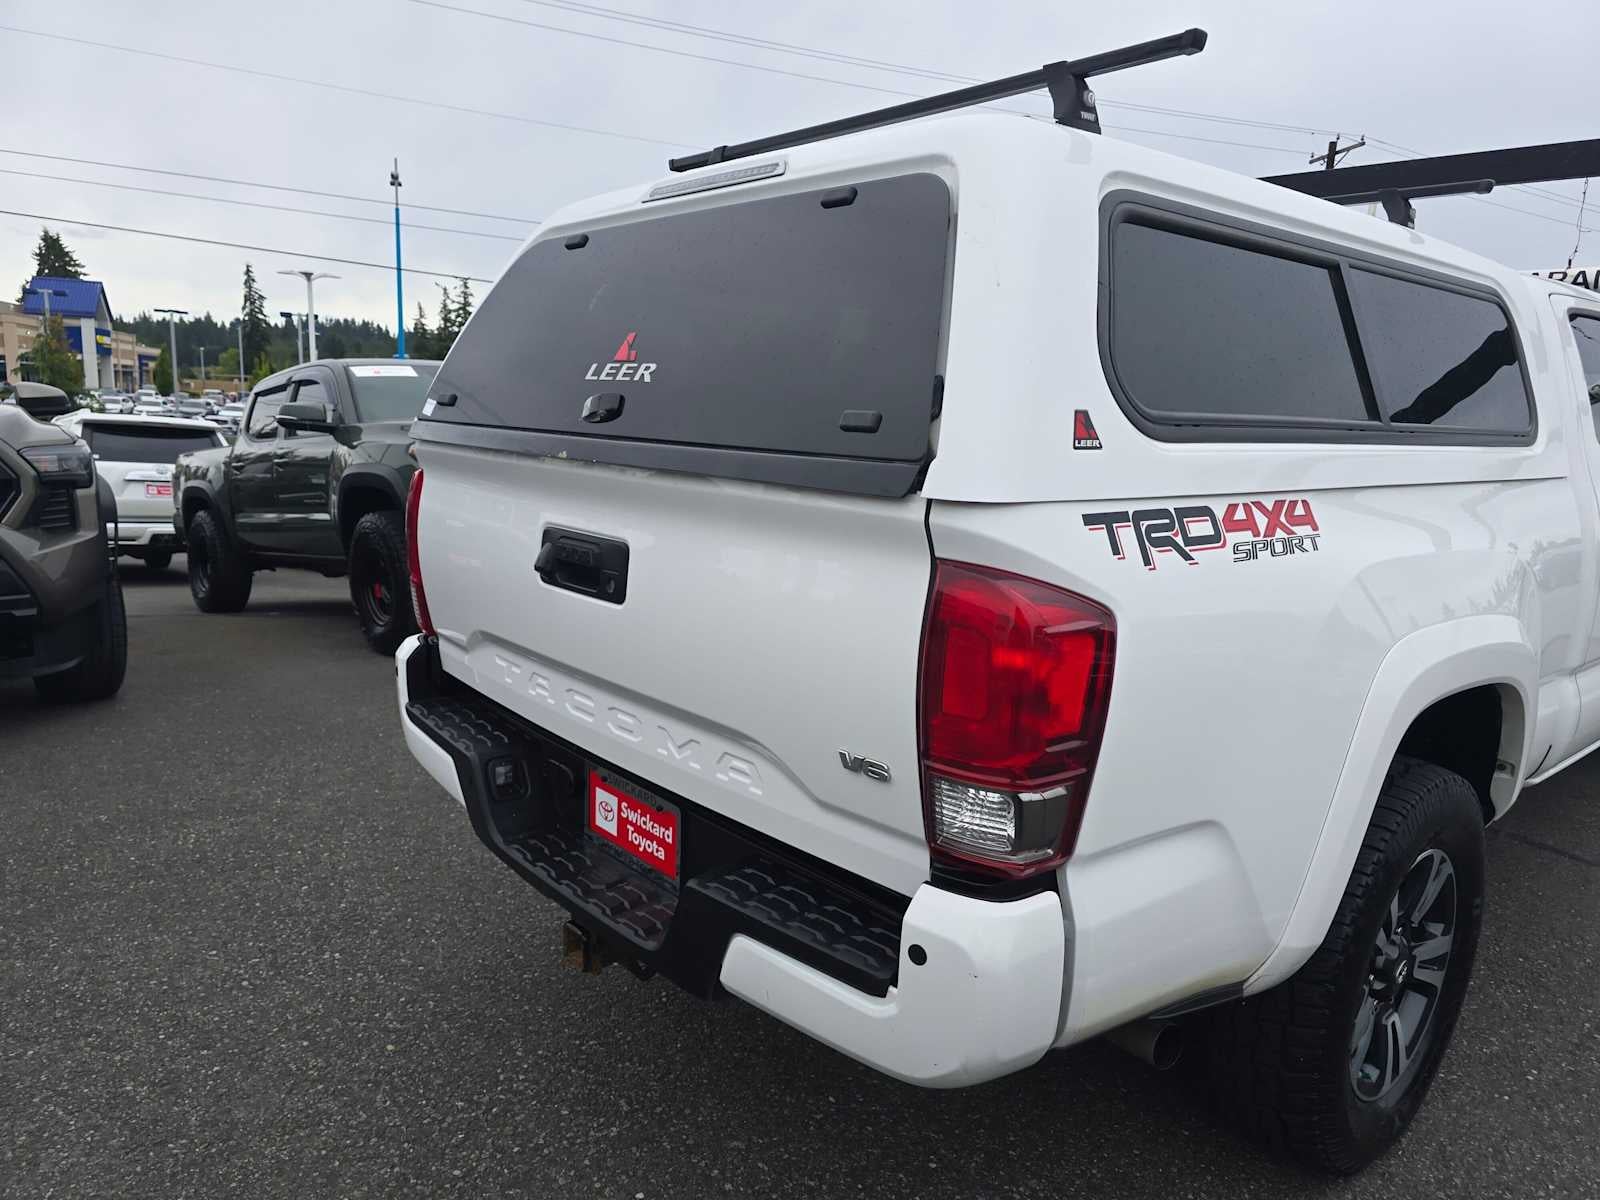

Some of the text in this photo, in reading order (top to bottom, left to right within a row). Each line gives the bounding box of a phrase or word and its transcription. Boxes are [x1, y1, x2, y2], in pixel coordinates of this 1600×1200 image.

[584, 362, 657, 383] LEER
[1074, 439, 1101, 448] LEER
[1081, 504, 1227, 571] TRD
[1232, 533, 1321, 563] SPORT
[495, 654, 763, 796] TACOMA
[838, 748, 892, 783] V6
[620, 801, 673, 845] Swickard
[626, 824, 665, 861] Toyota
